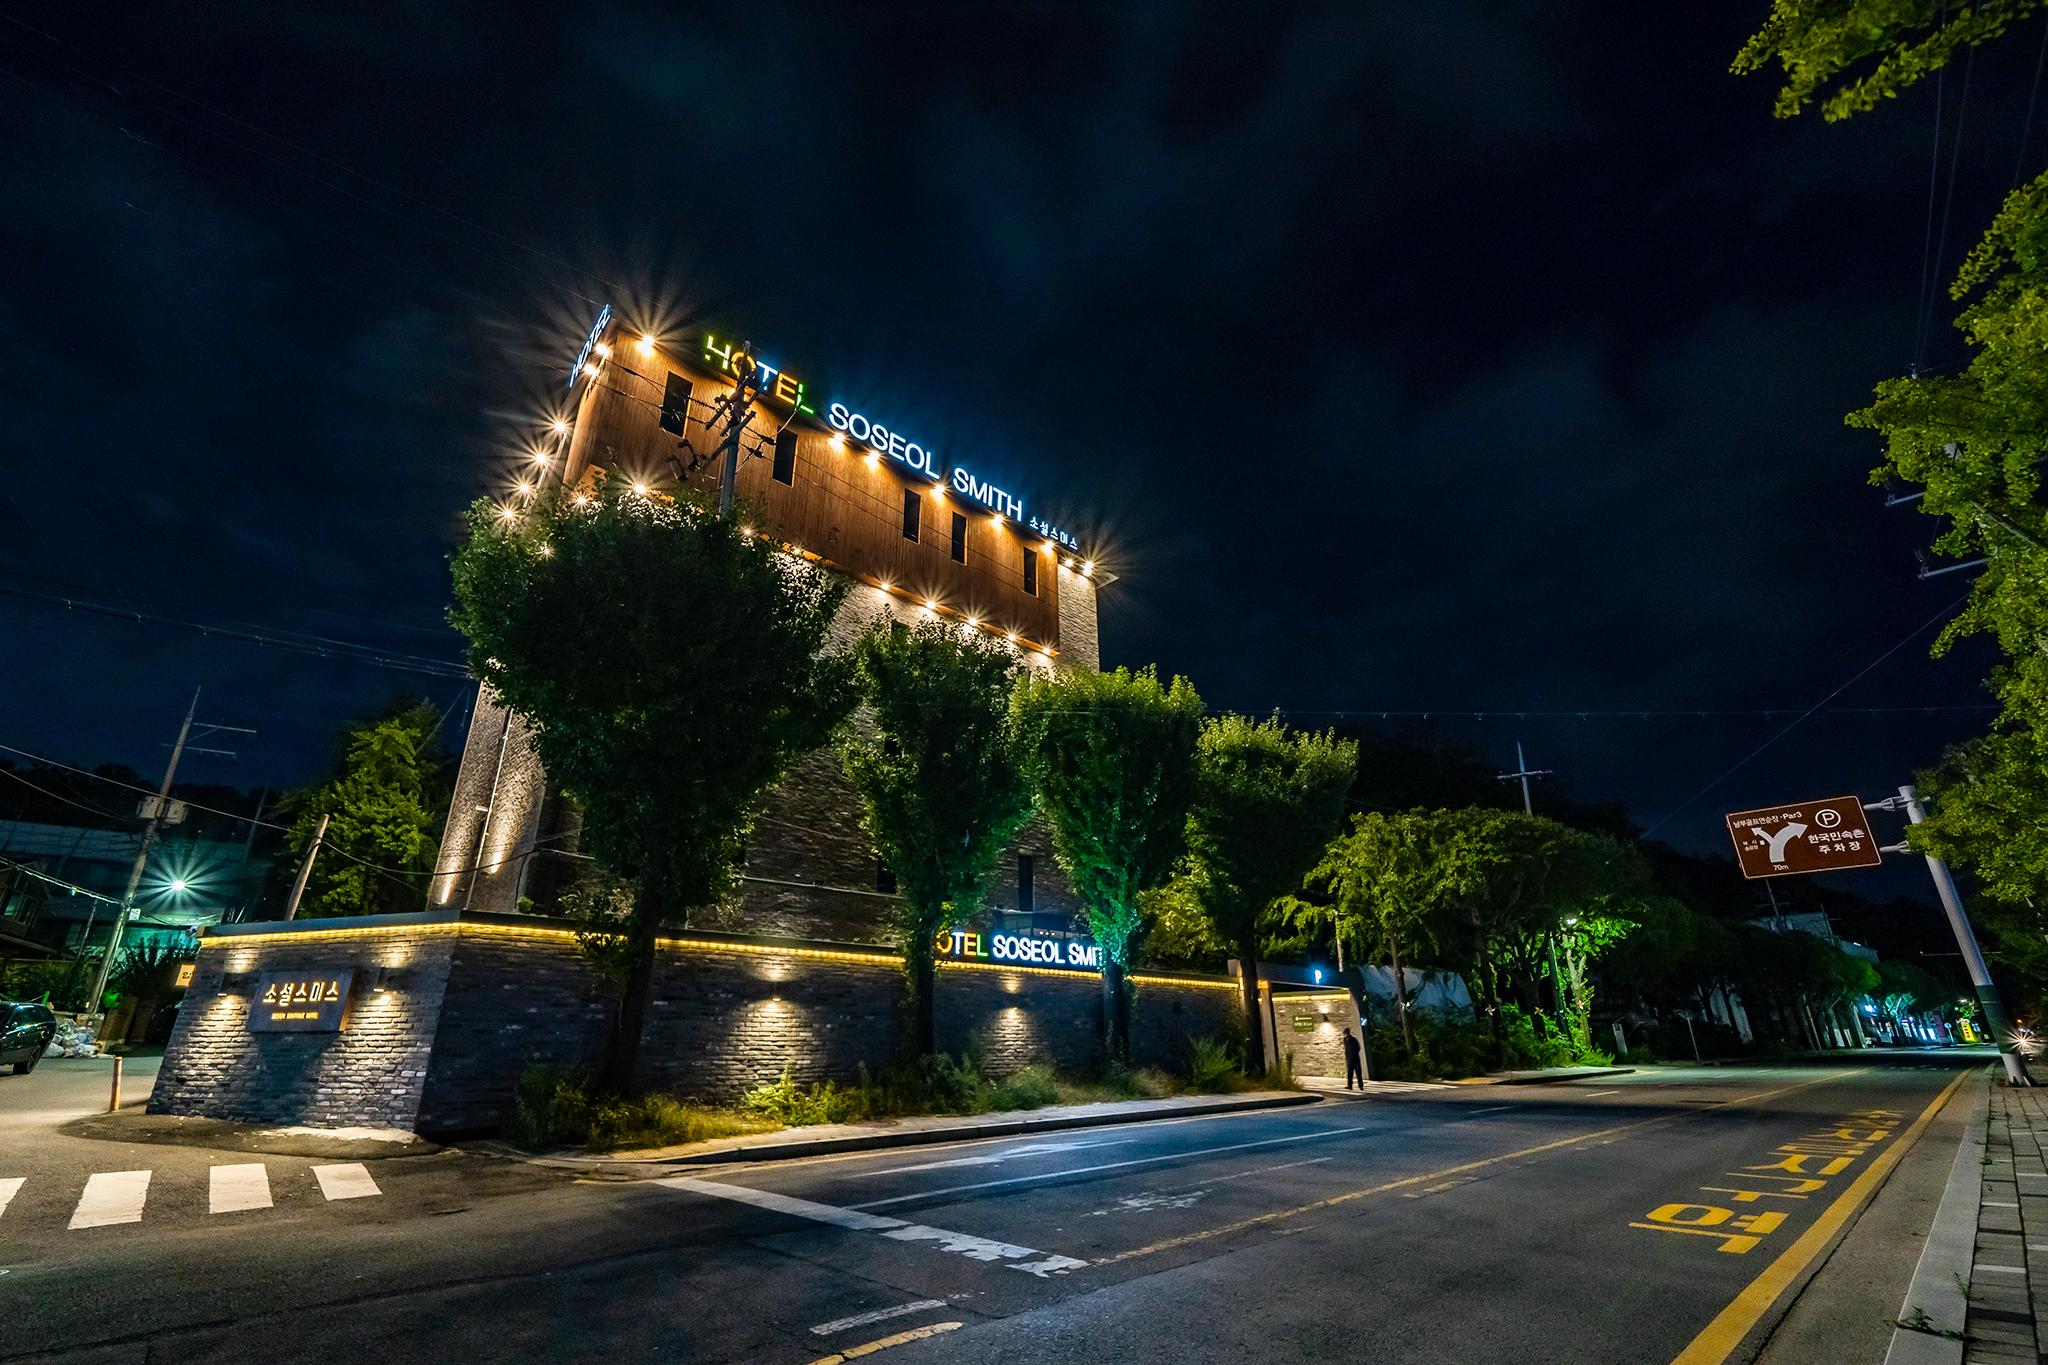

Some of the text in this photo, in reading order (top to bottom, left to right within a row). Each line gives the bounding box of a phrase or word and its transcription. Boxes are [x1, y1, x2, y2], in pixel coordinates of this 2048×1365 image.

[704, 335, 1024, 523] HOTEL SOSEOL SMITH
[1029, 516, 1079, 551] 소설스미스
[1808, 828, 1865, 844] 한국민속촌
[1773, 864, 1789, 872] 70m
[935, 929, 989, 957] OTEL
[993, 934, 1066, 964] SOSEOL
[262, 980, 339, 1007] 소설스미스
